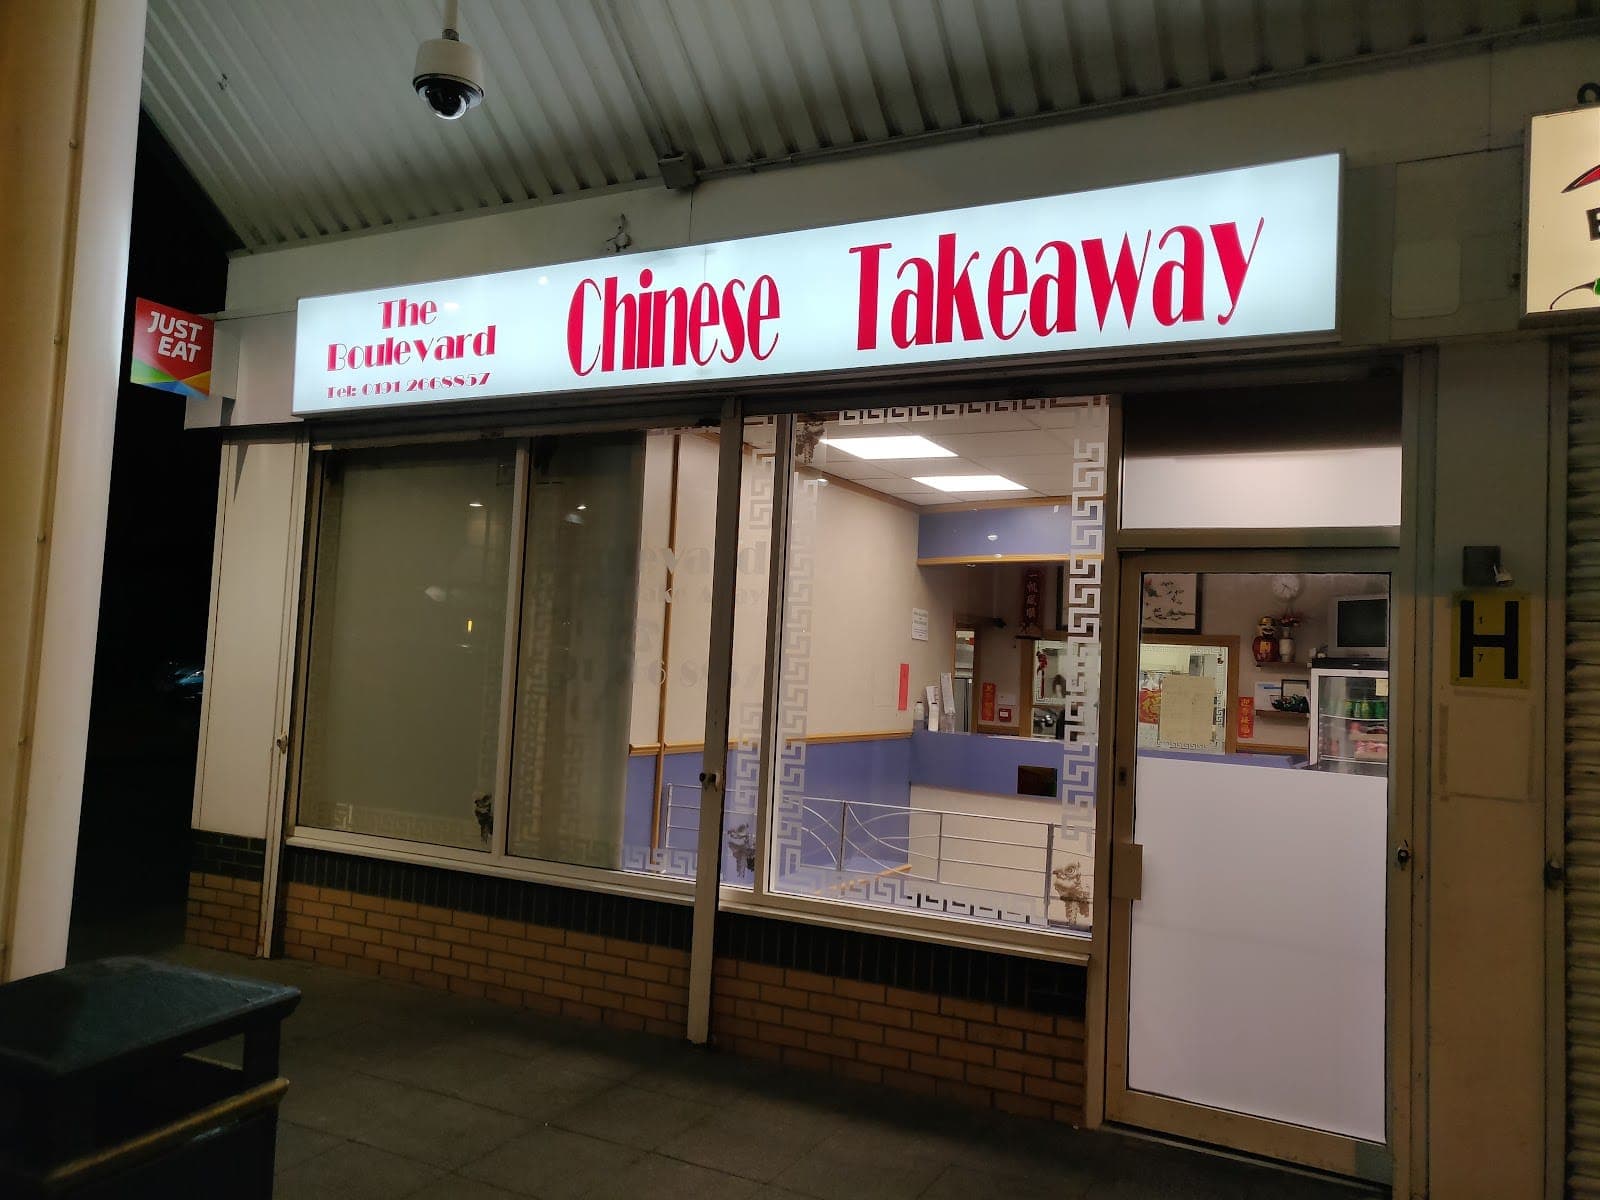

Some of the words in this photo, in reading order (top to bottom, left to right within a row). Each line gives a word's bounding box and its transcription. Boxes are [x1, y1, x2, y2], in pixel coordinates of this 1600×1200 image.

[567, 269, 781, 376] Chinese
[849, 216, 1263, 351] Takeaway
[147, 310, 203, 341] JUST
[378, 297, 438, 329] The
[157, 336, 201, 364] EAT
[327, 325, 496, 371] Boulevard
[327, 385, 358, 398] Tel:
[361, 375, 402, 395] 0191
[407, 371, 491, 392] 2668857
[1459, 601, 1520, 680] H
